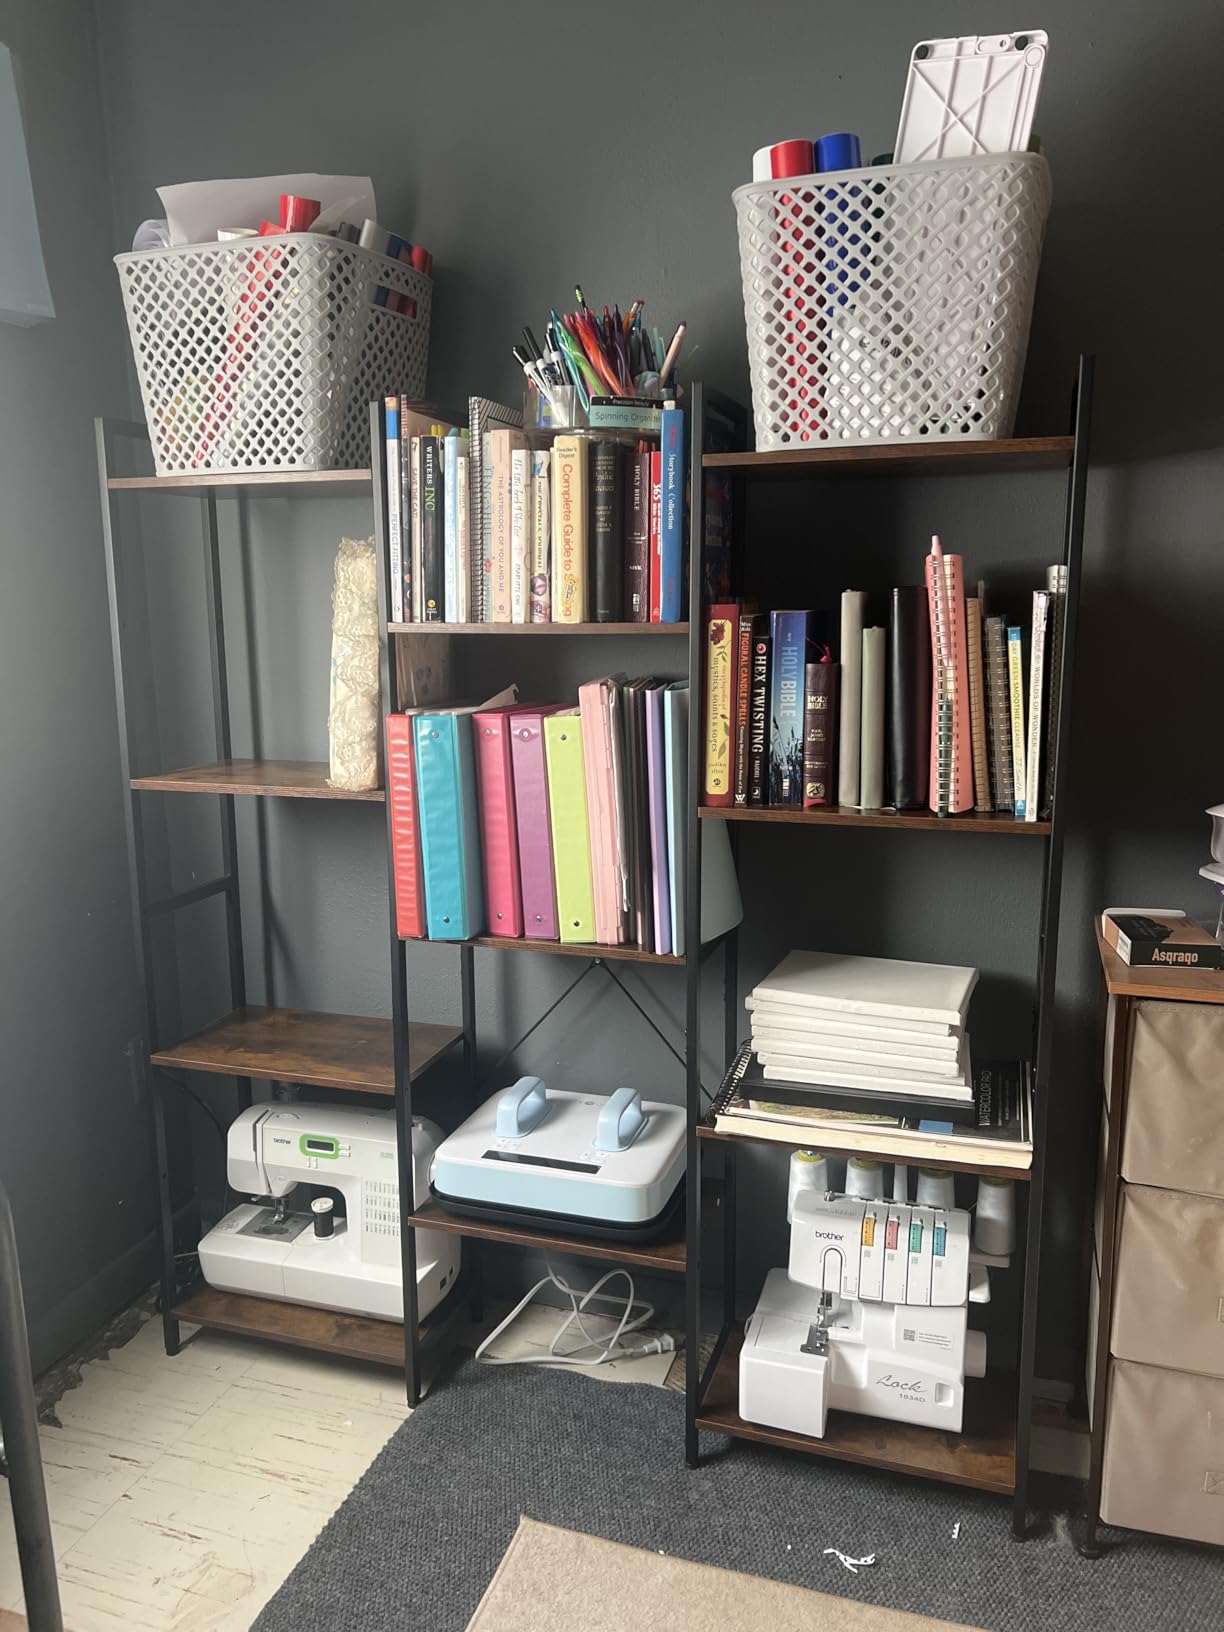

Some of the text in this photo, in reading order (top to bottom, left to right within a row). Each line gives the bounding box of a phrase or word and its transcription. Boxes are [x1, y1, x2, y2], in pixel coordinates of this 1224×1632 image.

[595, 411, 628, 423] Spinning
[667, 454, 677, 490] Storybook
[424, 486, 435, 511] INC
[561, 463, 573, 521] Complete
[653, 483, 662, 501] 365
[667, 493, 676, 530] Collection
[391, 513, 399, 546] PERFECT
[498, 535, 504, 545] OF
[563, 524, 574, 558] Guide
[392, 548, 400, 575] FITTING
[563, 559, 573, 571] to
[498, 582, 504, 593] ME
[738, 632, 750, 726] FIGURAL CANDLE SPELLS
[1033, 666, 1041, 700] WORLDS
[752, 655, 767, 753] HEX TWISTING
[1013, 682, 1021, 720] SMOOTHIE
[1033, 701, 1039, 711] OF
[707, 729, 718, 753] sages
[1031, 714, 1039, 748] WONDER
[1151, 947, 1199, 965] Asqraqo
[978, 1083, 992, 1126] WATERCOLOR
[273, 1137, 291, 1145] brother
[815, 1231, 844, 1241] brother
[875, 1374, 928, 1393] Lock
[899, 1393, 926, 1403] 1034D
